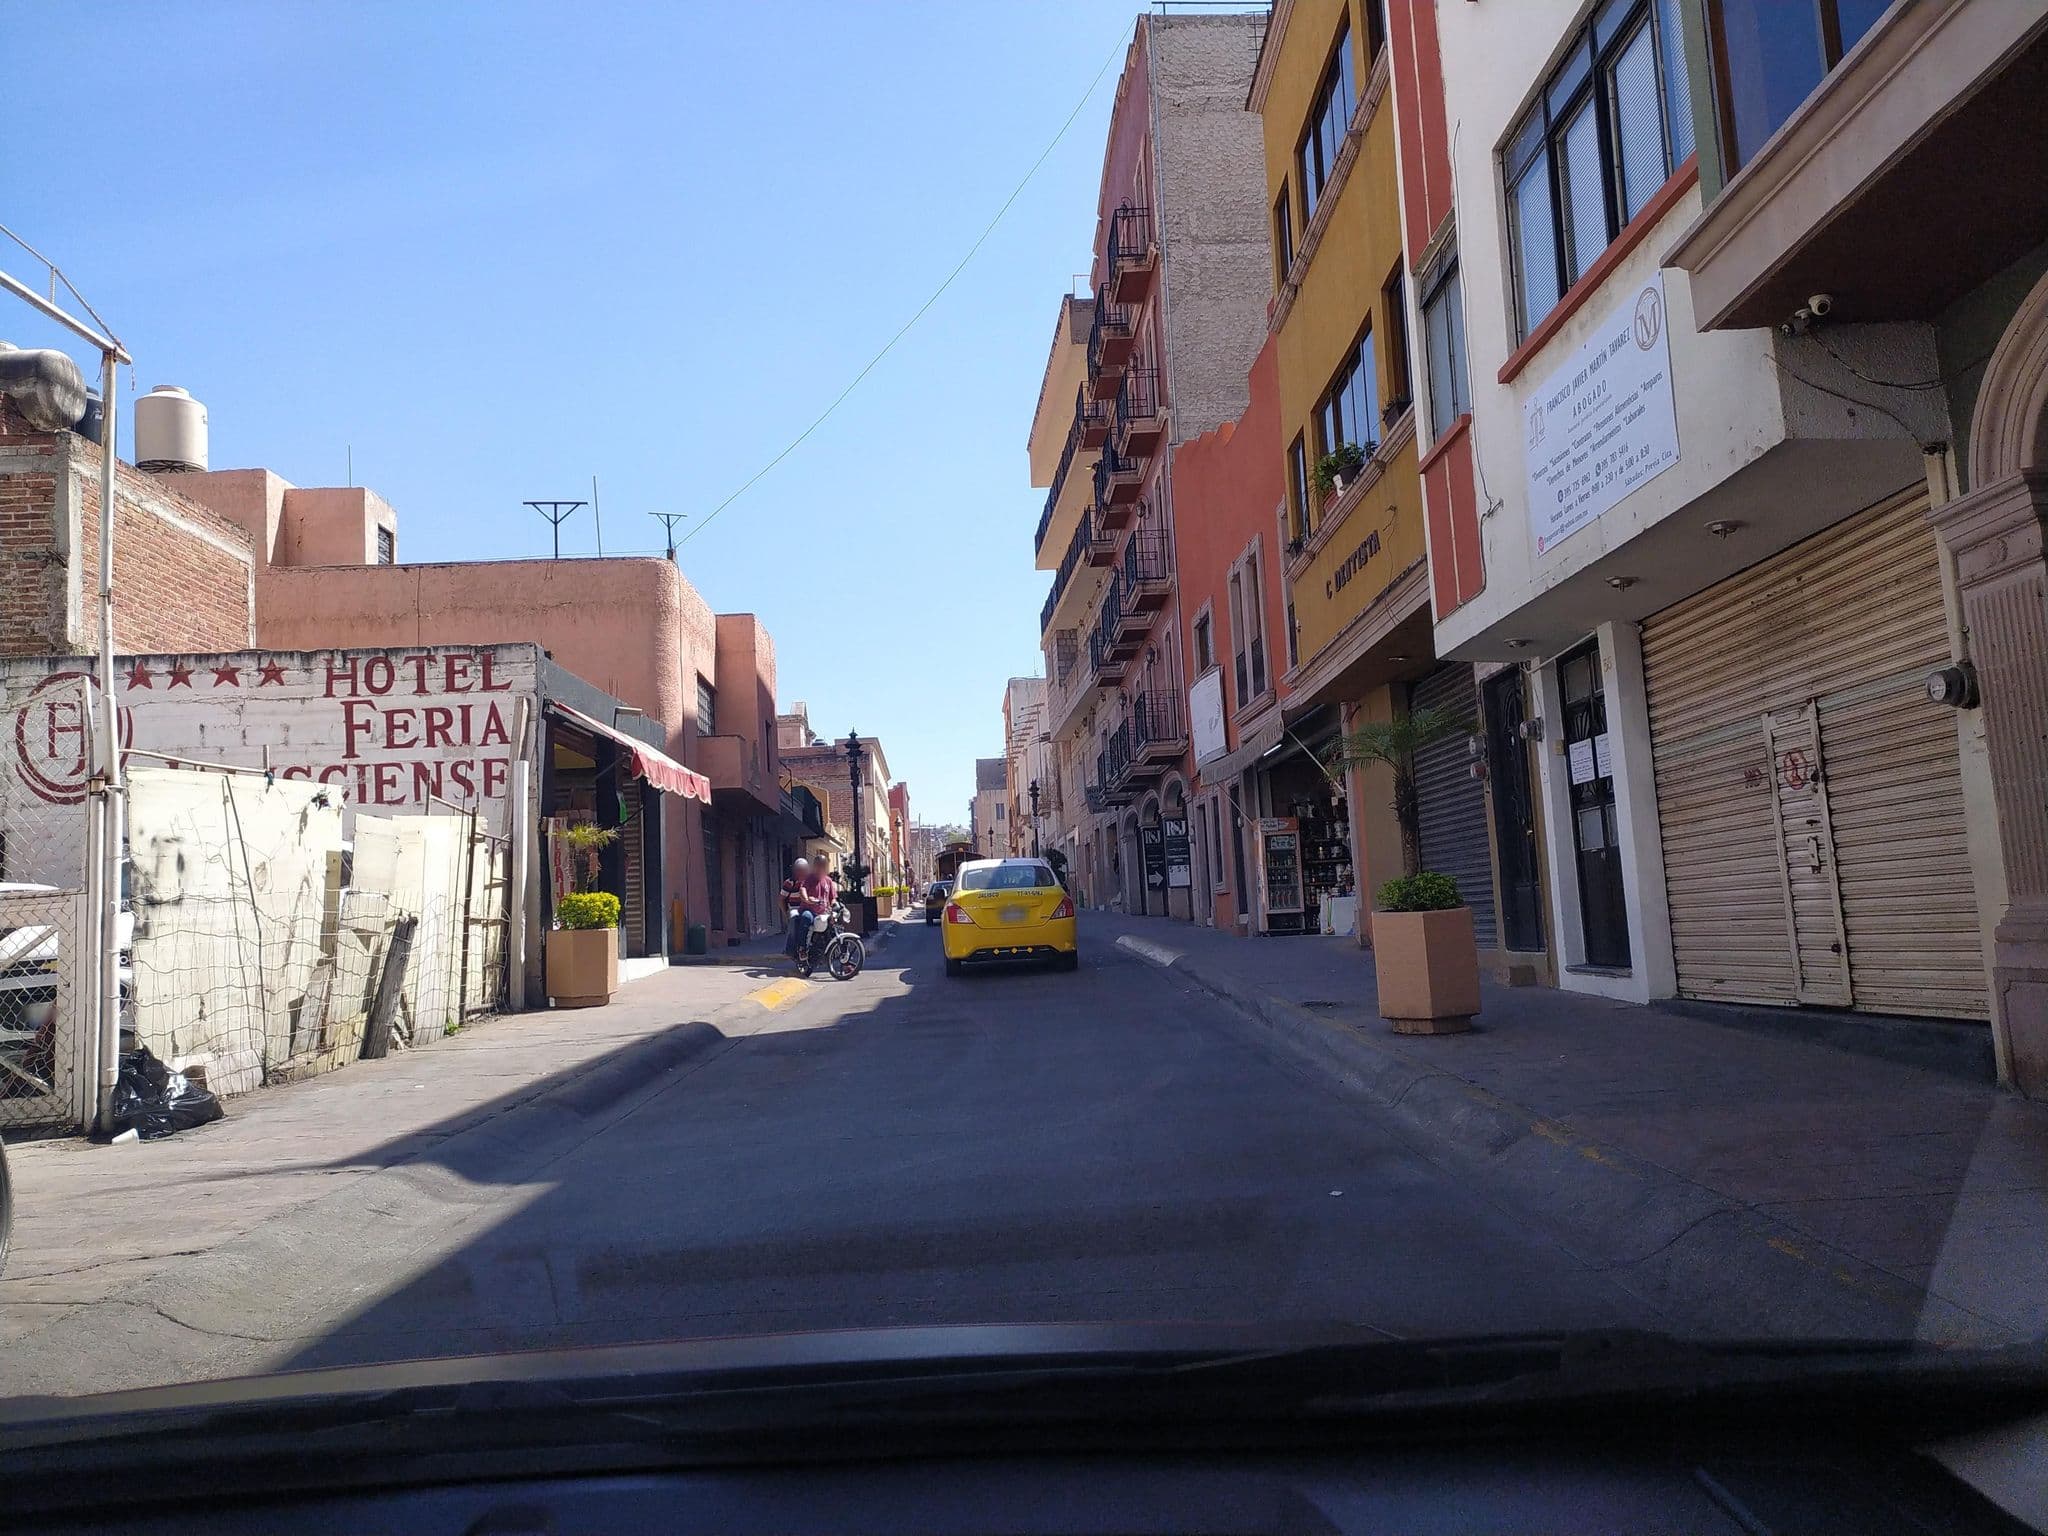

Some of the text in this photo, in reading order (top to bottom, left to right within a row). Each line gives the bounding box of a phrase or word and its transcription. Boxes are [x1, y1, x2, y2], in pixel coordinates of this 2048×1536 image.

[1546, 381, 1570, 415] FRANCISCO
[1571, 366, 1587, 394] JAVIER
[1572, 378, 1607, 419] ABOGADO
[323, 652, 513, 698] HOTEL
[340, 699, 511, 759] FERIA
